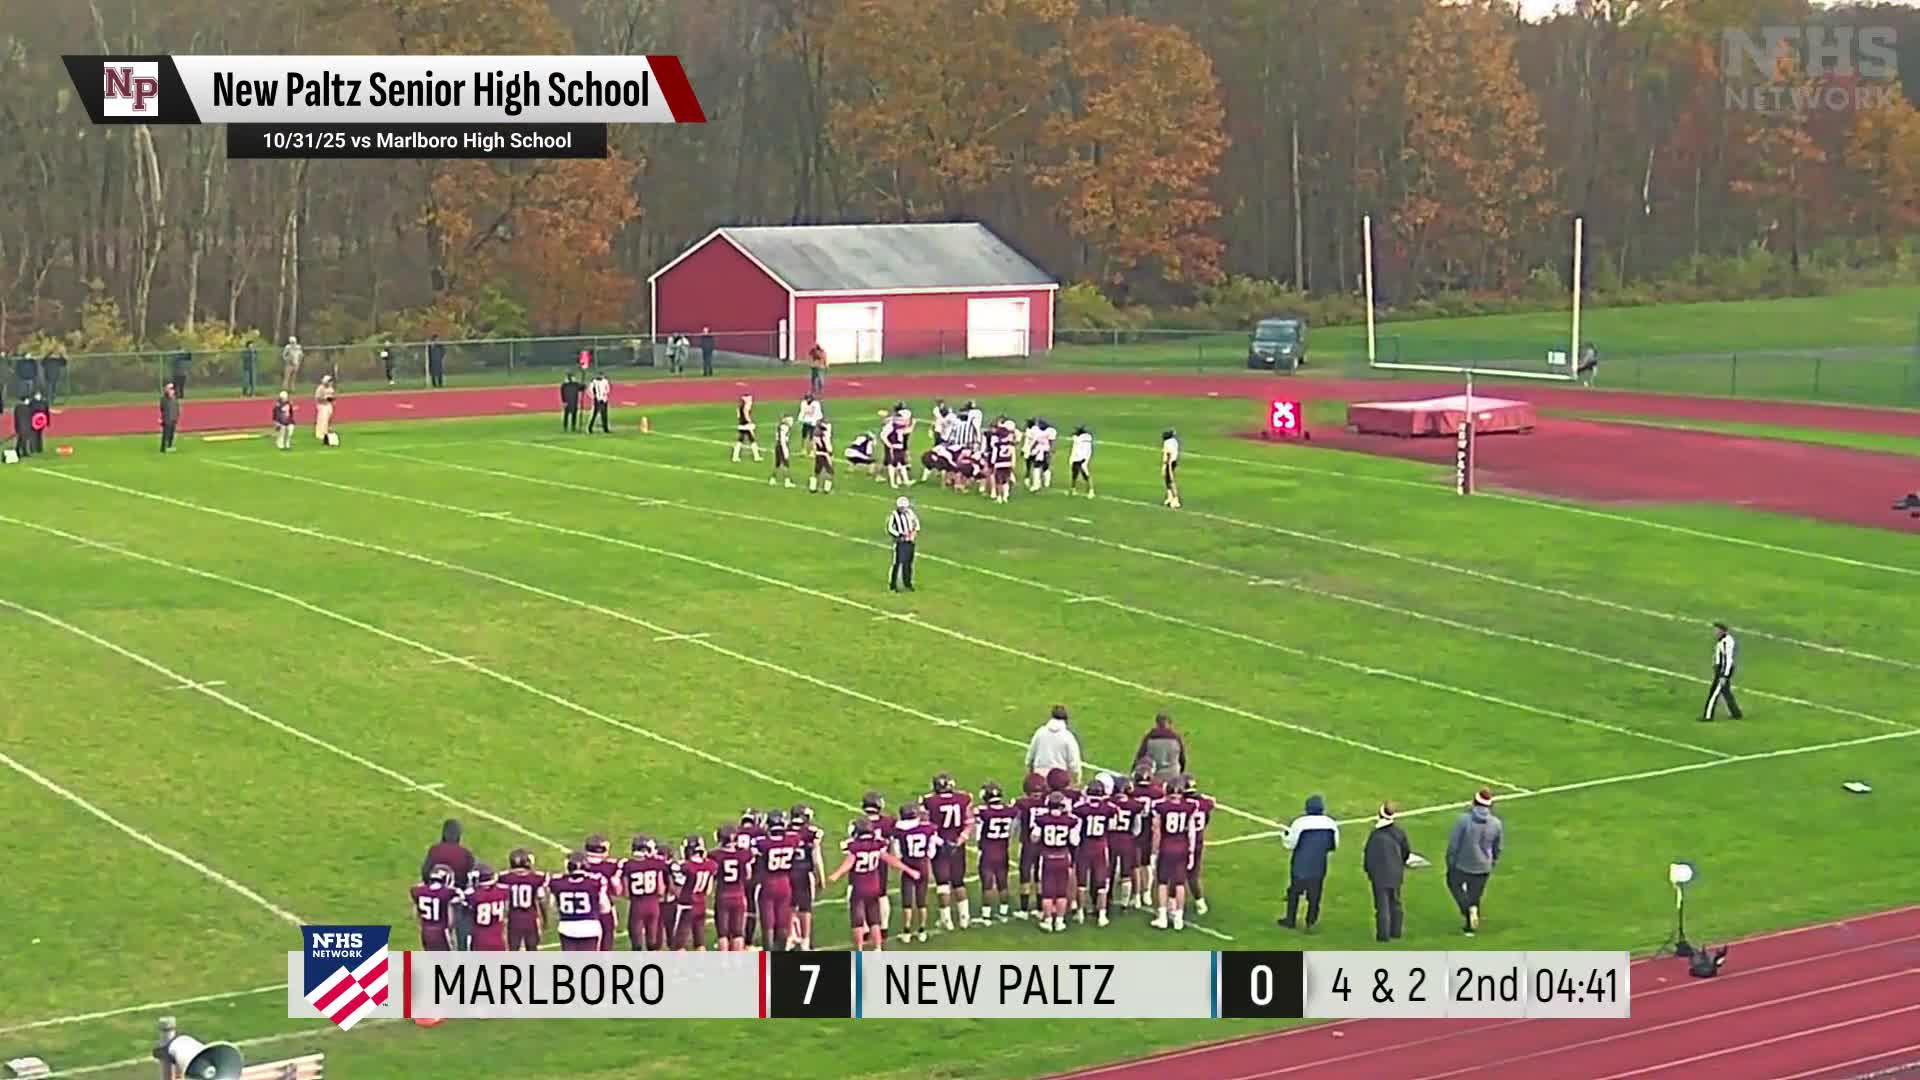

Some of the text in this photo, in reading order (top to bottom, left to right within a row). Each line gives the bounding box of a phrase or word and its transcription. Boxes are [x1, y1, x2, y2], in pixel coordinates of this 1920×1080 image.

[1273, 402, 1296, 428] 25
[939, 804, 961, 829] 71
[986, 817, 1013, 839] 53
[1086, 814, 1107, 836] 16
[1165, 811, 1187, 834] 81
[905, 833, 927, 858] 12
[1043, 824, 1069, 847] 82
[767, 846, 794, 871] 62
[855, 851, 881, 874] 20
[630, 870, 657, 896] 28
[723, 859, 739, 883] 5
[511, 884, 533, 908] 10
[559, 891, 592, 914] 63
[418, 896, 440, 921] 51
[476, 901, 505, 926] 84
